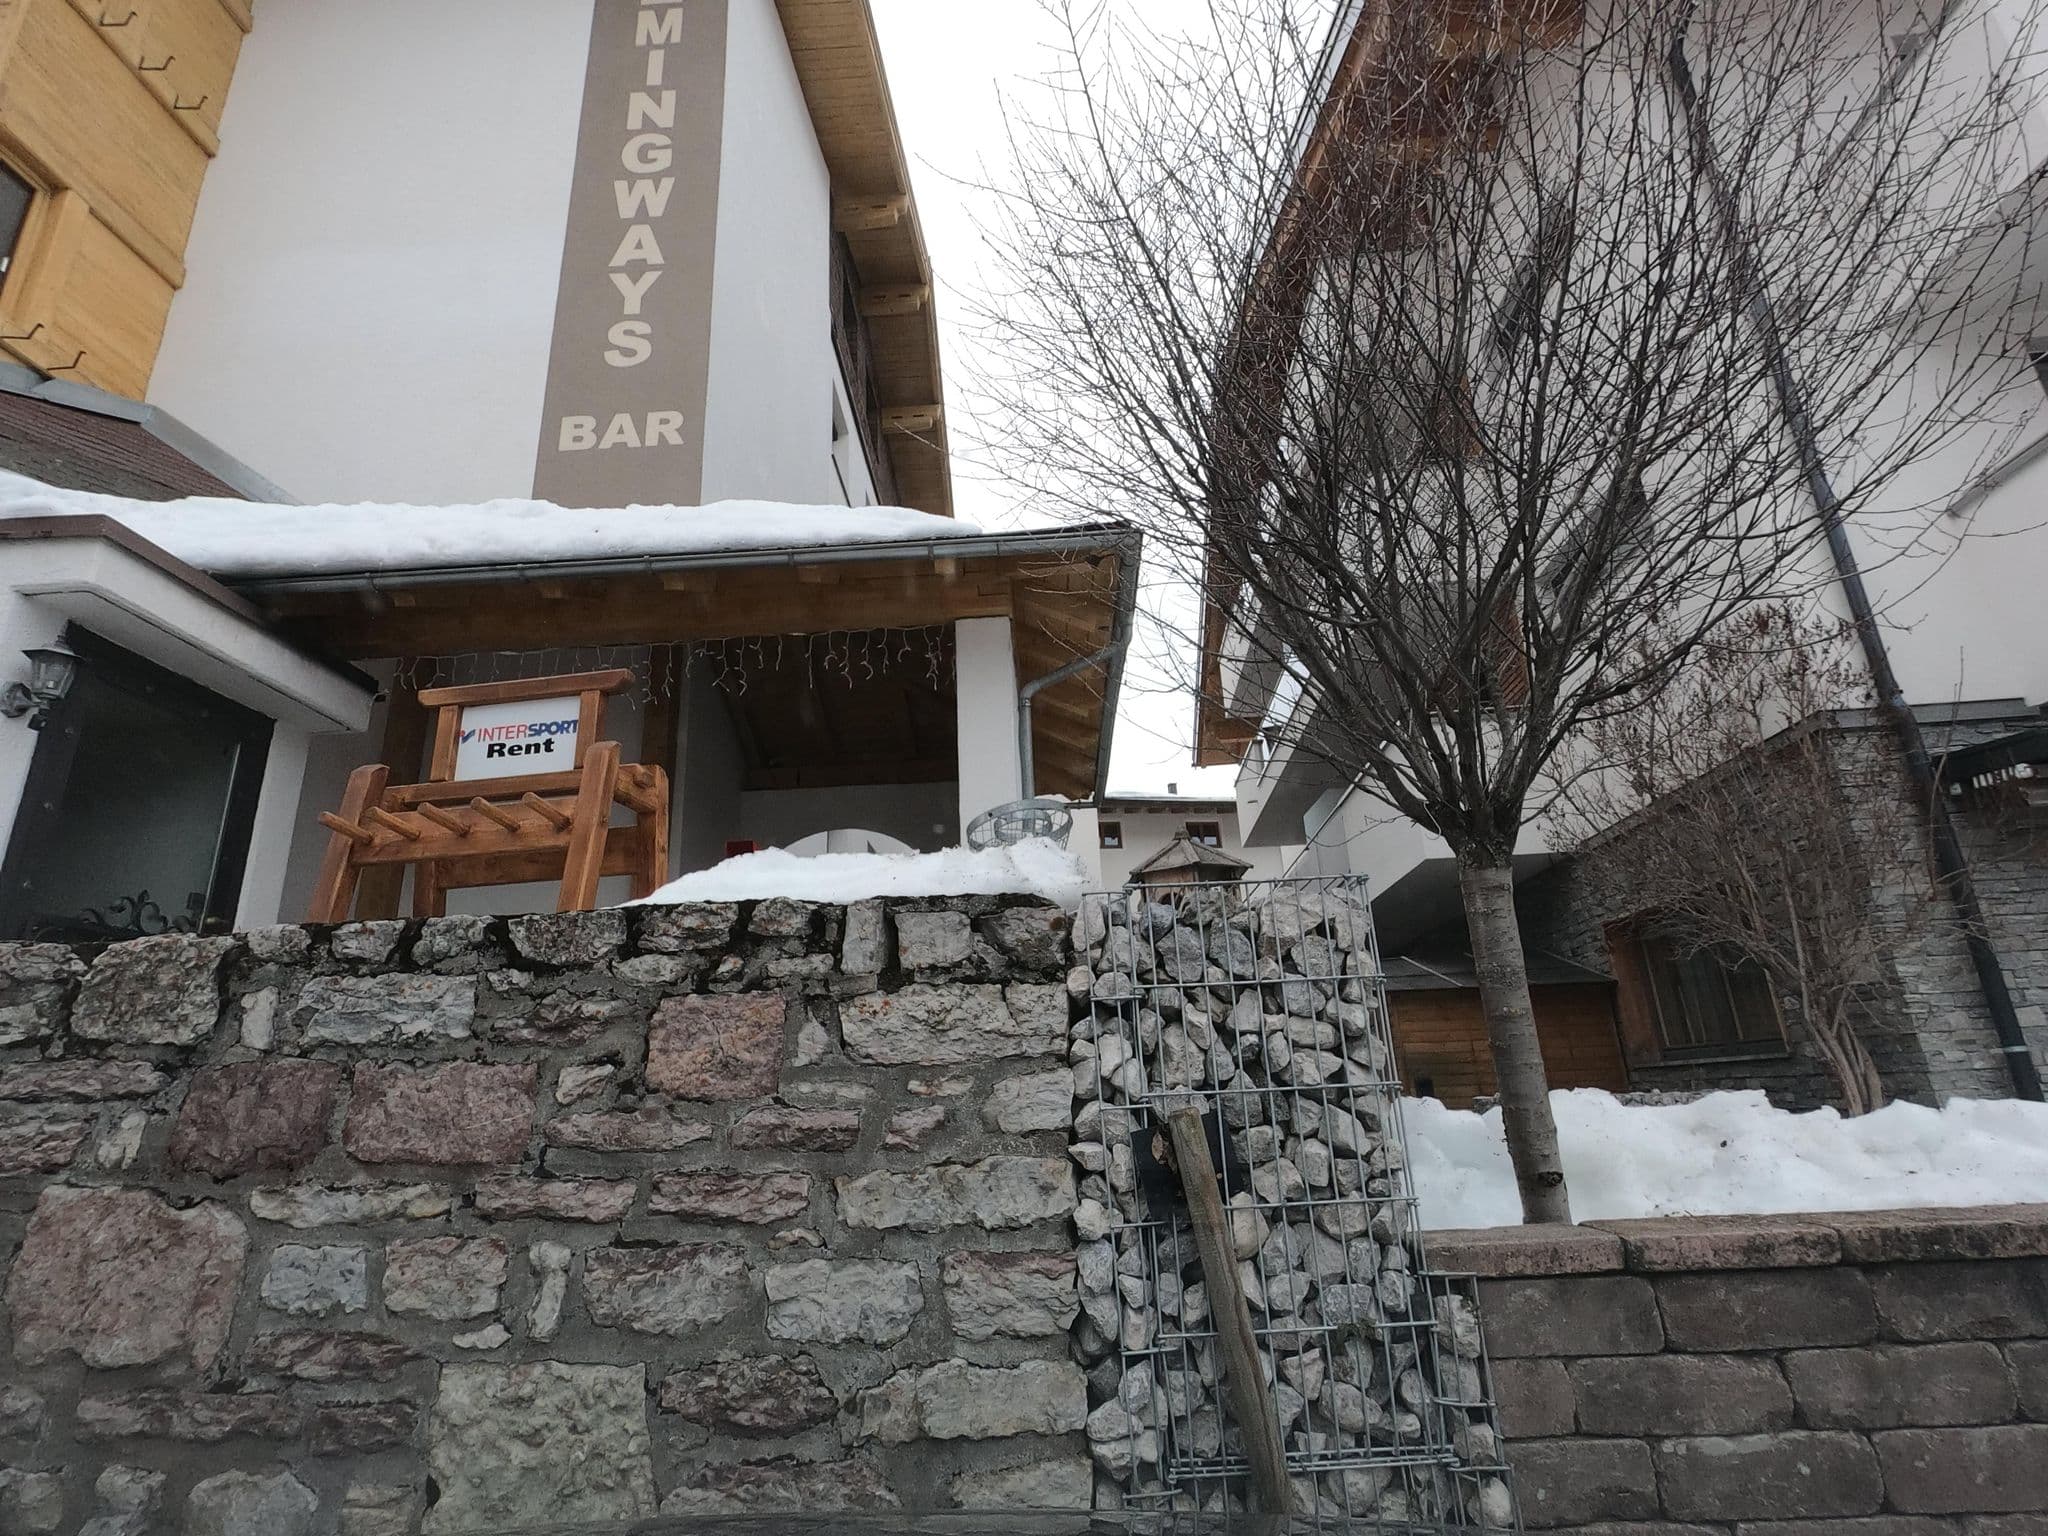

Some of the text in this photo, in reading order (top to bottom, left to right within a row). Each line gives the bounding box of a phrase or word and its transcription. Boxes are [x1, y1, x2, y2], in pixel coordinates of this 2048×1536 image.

[603, 0, 684, 367] MINGWAYS
[558, 410, 685, 452] BAR
[477, 719, 579, 743] INTERSPORT
[486, 738, 555, 759] Rent
